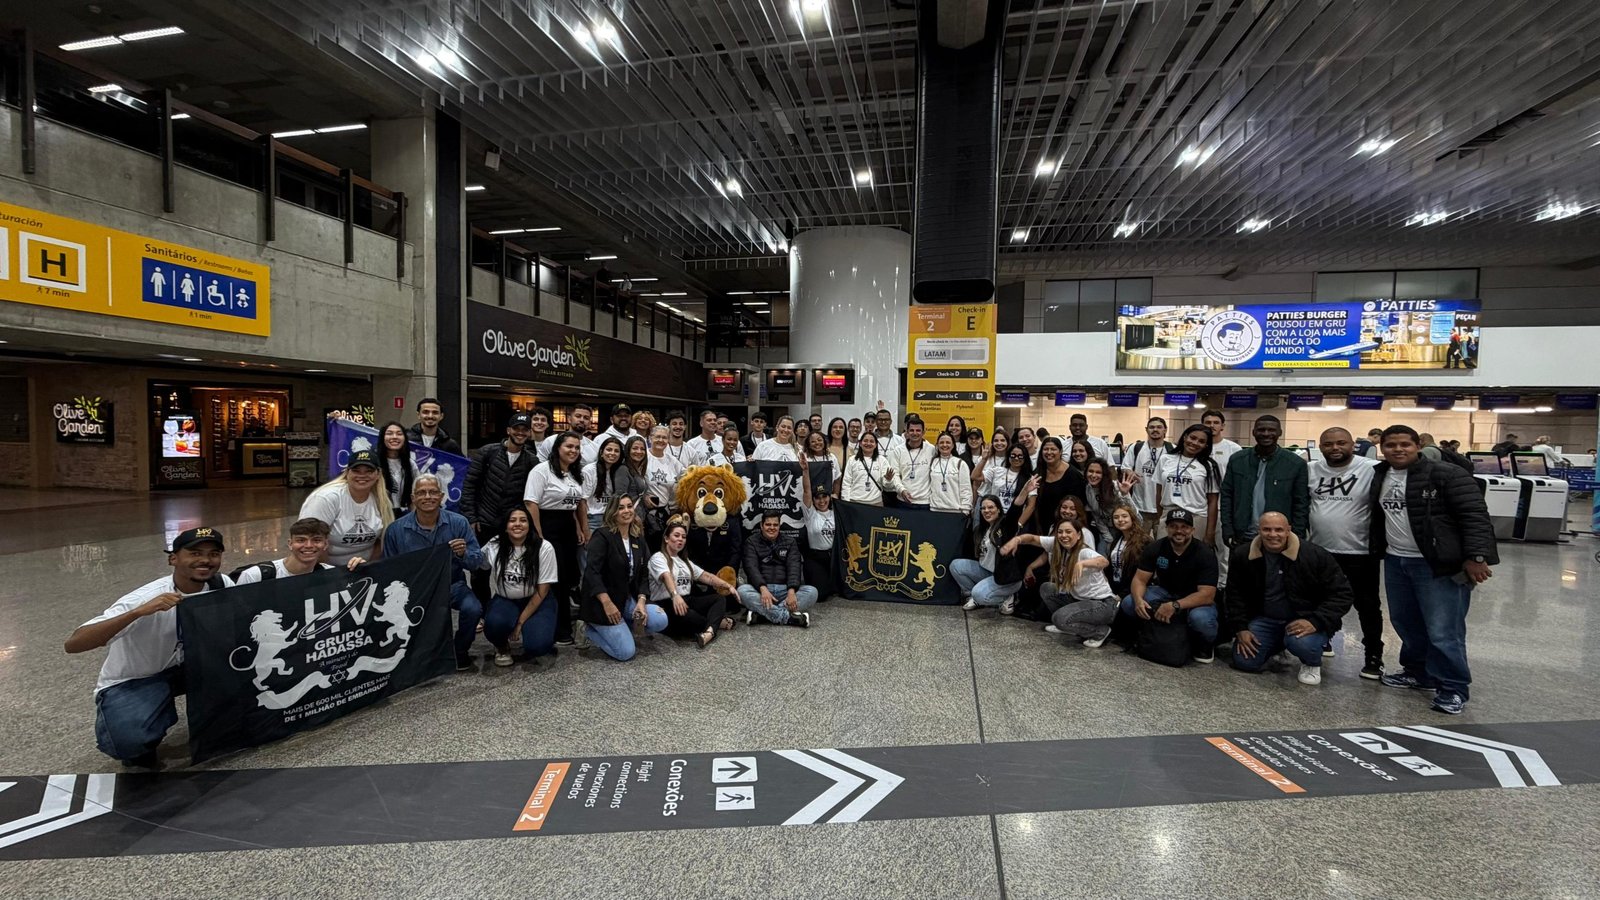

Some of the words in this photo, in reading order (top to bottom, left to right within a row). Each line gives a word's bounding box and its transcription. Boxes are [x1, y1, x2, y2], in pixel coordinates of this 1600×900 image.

[41, 249, 66, 277] H
[144, 244, 198, 263] Sanitários
[52, 289, 70, 298] min
[1306, 310, 1347, 318] BURGER
[1381, 300, 1436, 310] PATTIES
[926, 320, 935, 332] 2
[966, 316, 976, 330] E
[1210, 312, 1254, 326] PATTIES
[1266, 320, 1306, 328] POUSOU
[1326, 320, 1346, 328] GRU
[482, 329, 526, 358] Olive
[526, 339, 576, 368] Garden
[1264, 347, 1305, 355] MUNDO!
[1265, 337, 1304, 346] ICÔNICA
[53, 404, 85, 420] Olive
[58, 418, 104, 436] Garden
[758, 474, 794, 496] HV
[1166, 476, 1192, 485] STAFF
[1382, 502, 1406, 510] STAF
[342, 536, 376, 544] STAFF
[304, 583, 378, 640] HV
[314, 628, 365, 651] GRUPO
[306, 636, 374, 663] HADASSA
[283, 706, 304, 716] MAIS
[304, 702, 314, 710] DE
[316, 697, 330, 706] 600
[330, 693, 344, 702] MIL
[344, 680, 375, 696] CLIENTES
[284, 714, 296, 723] DE
[304, 701, 335, 718] MILHÃO
[336, 698, 347, 706] DE
[578, 762, 593, 772] de
[1218, 742, 1274, 775] Terminal
[1270, 778, 1292, 786] 2
[1306, 734, 1398, 782] Conexões
[636, 760, 654, 782] Flight
[528, 768, 562, 809] Terminal
[568, 773, 586, 800] vuelos
[584, 762, 611, 808] Conexiones
[610, 761, 632, 808] connections
[662, 759, 688, 817] Conexões
[520, 813, 544, 822] 2
